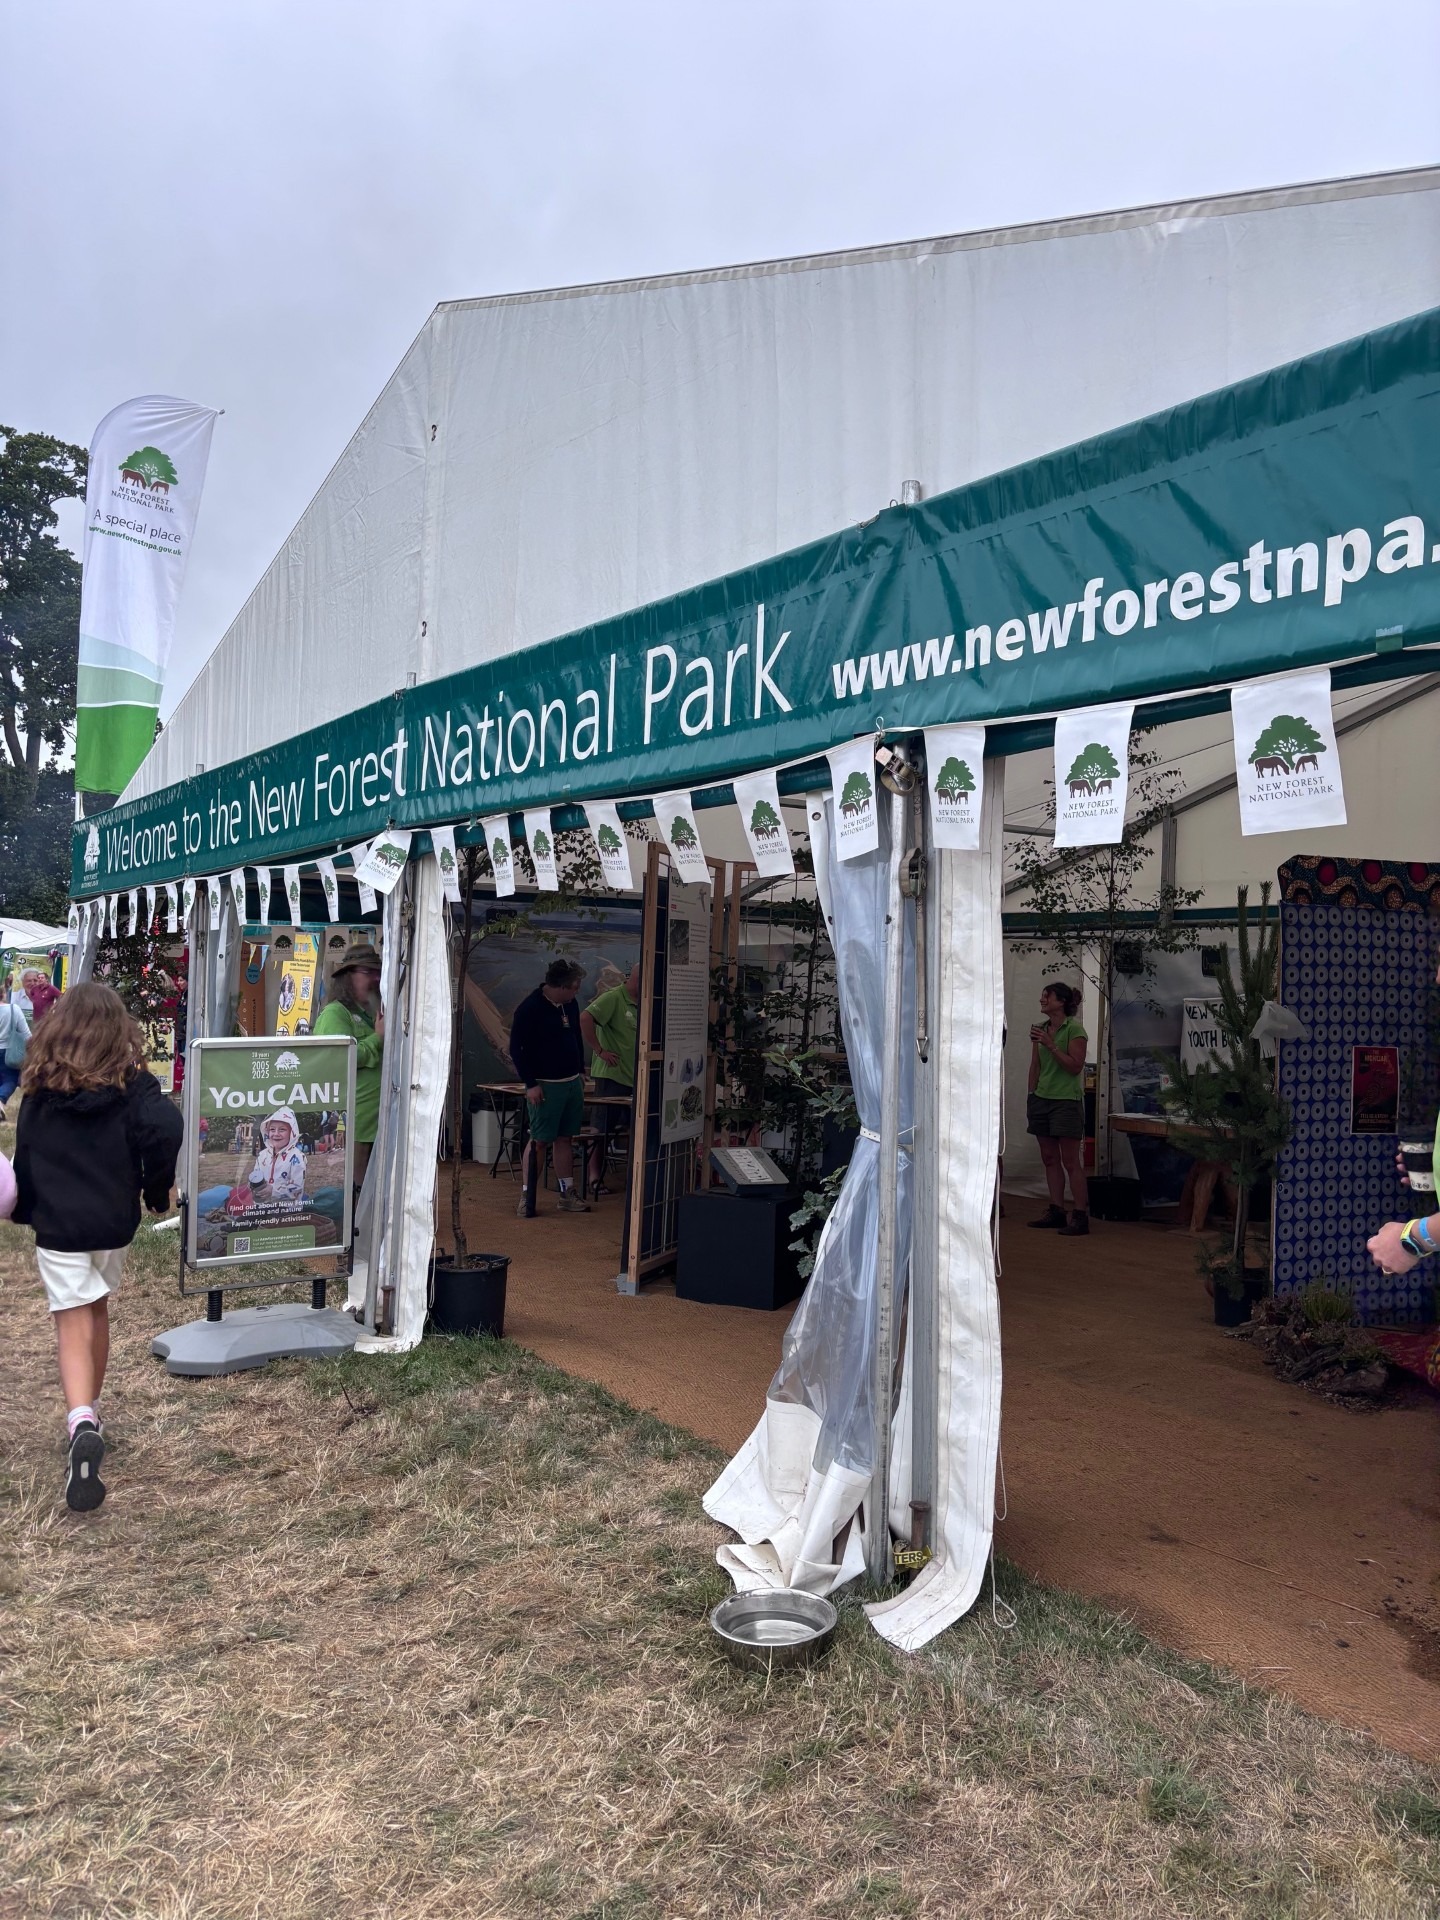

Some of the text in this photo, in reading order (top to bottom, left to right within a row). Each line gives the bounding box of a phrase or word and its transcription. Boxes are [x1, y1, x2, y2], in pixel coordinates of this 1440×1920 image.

[111, 490, 174, 514] NATIONAL PARK
[118, 486, 170, 506] NEW FOREST
[94, 508, 181, 543] A special place
[88, 526, 182, 556] www.newforestnpa.gov.uk
[106, 603, 792, 874] Welcome to the New Forest National Park
[1256, 776, 1325, 792] NEW FOREST
[1249, 784, 1335, 803] NATIONAL PARK
[1062, 806, 1119, 820] NATIONAL PARK
[1068, 799, 1114, 811] NEW FOREST
[844, 820, 856, 829] NEW
[1188, 1030, 1218, 1048] YOUTH
[252, 1061, 270, 1070] 2005
[252, 1070, 270, 1079] 2025
[209, 1082, 340, 1108] YouCAN!
[232, 1218, 279, 1227] Family-friendly
